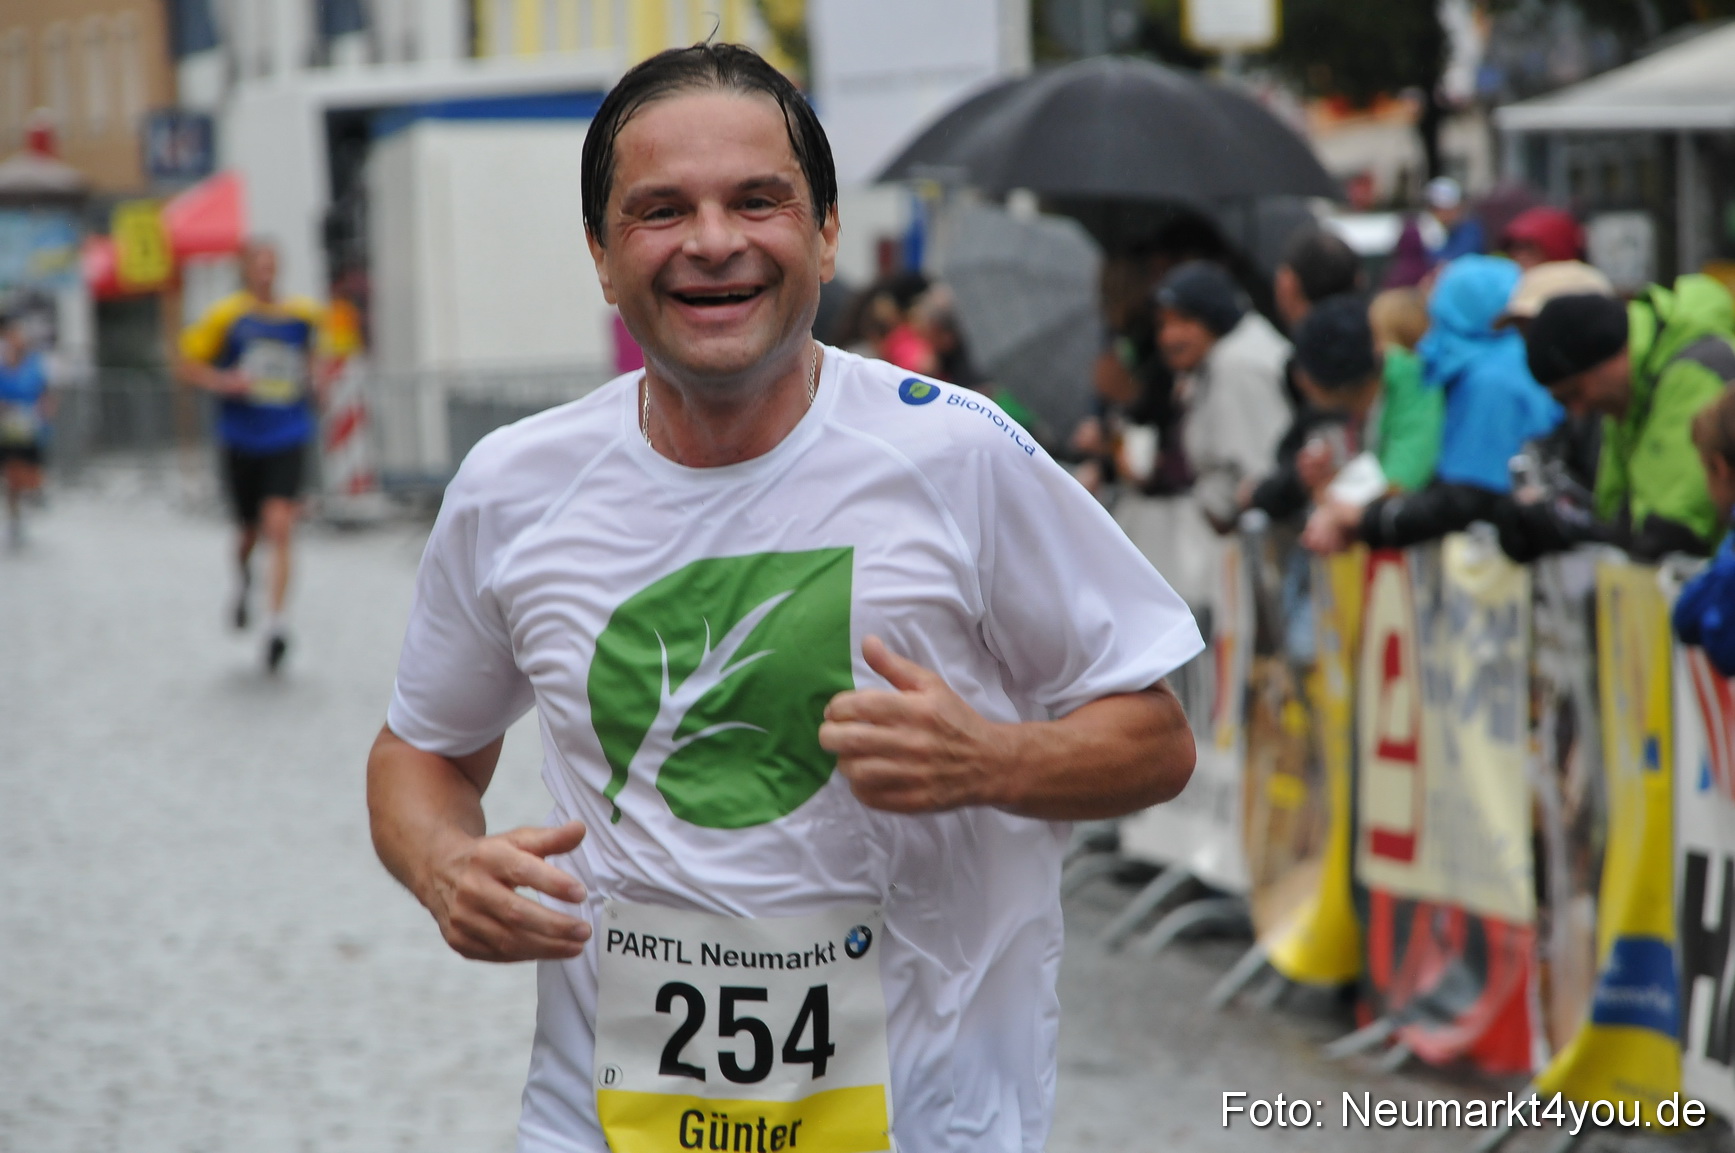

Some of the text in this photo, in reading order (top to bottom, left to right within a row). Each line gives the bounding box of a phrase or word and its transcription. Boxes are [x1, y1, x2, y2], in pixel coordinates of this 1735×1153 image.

[946, 393, 1036, 457] Bionorica
[606, 929, 837, 970] PARTL Neumarkt
[655, 981, 835, 1085] 254
[604, 1068, 616, 1085] D
[679, 1109, 802, 1153] Günter
